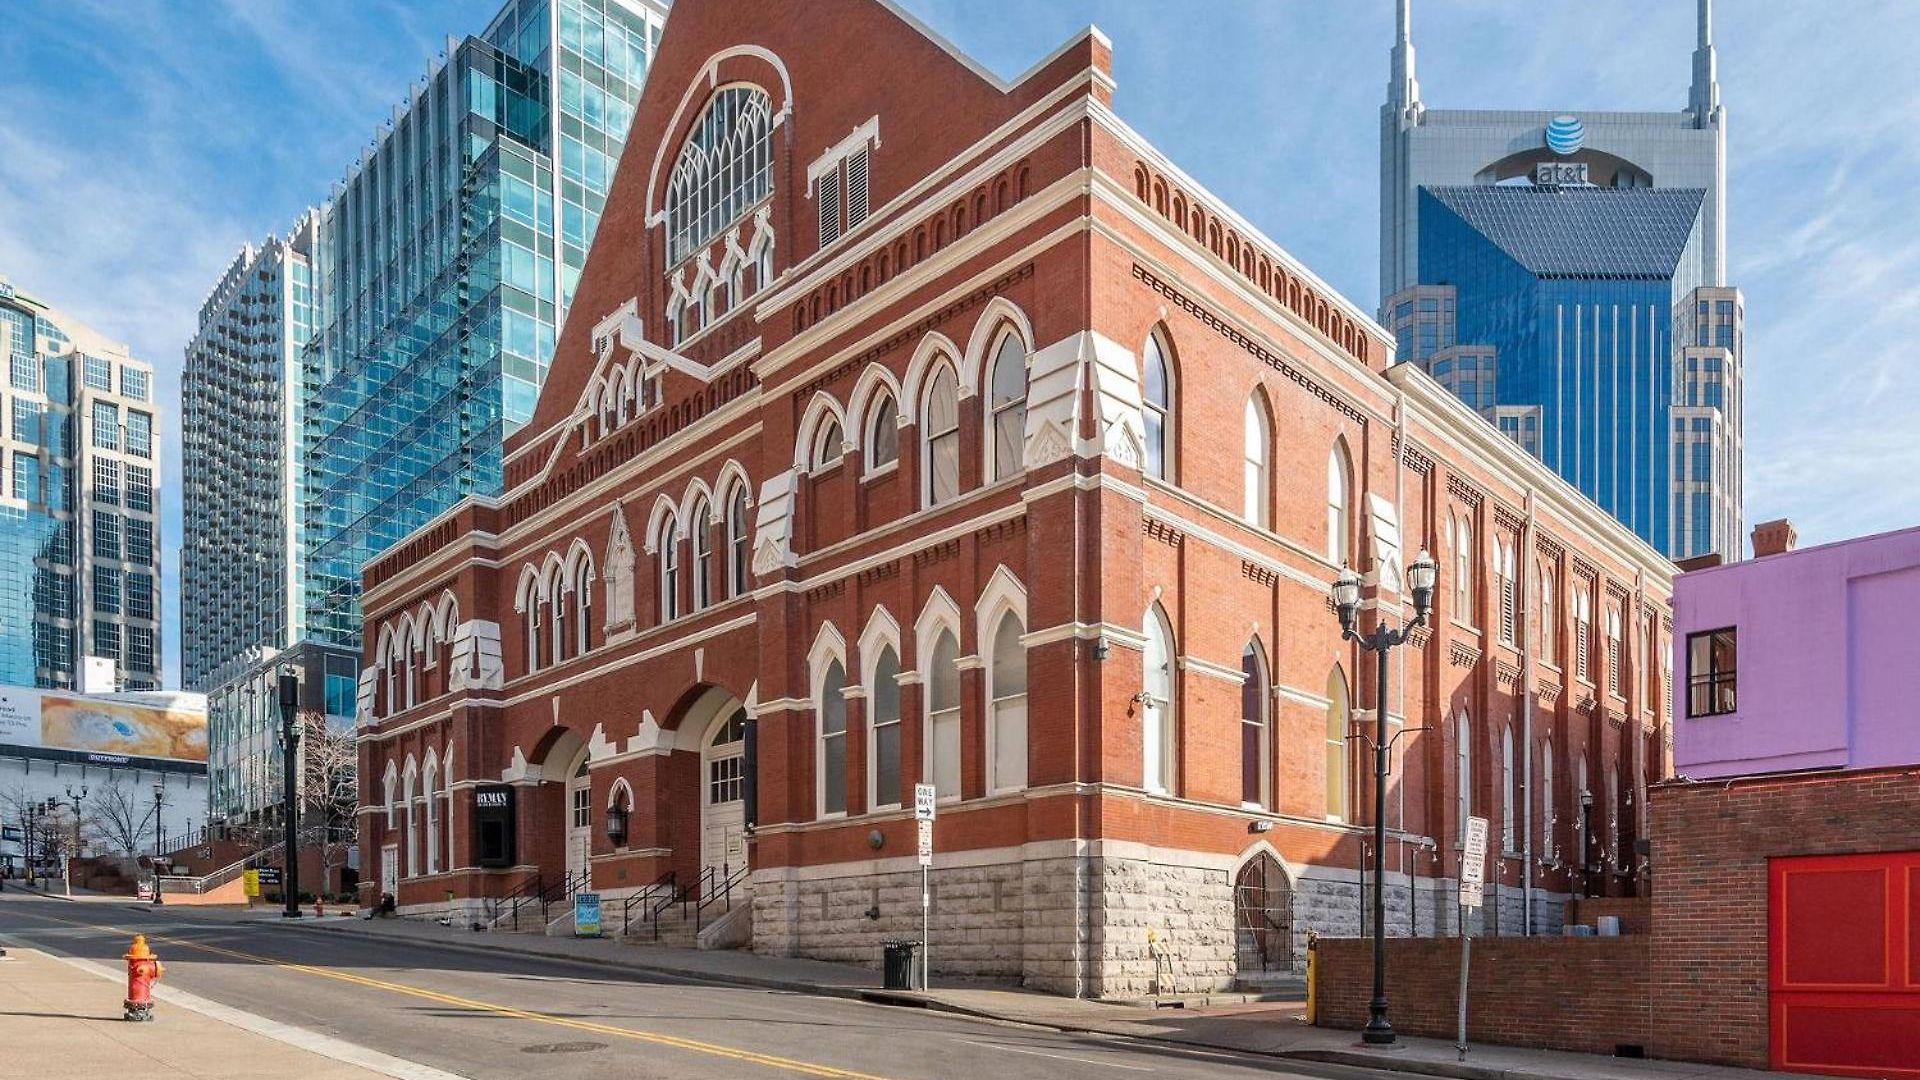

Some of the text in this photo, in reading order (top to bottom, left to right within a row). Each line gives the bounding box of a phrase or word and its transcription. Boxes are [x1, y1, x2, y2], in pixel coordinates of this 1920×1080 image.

[1540, 164, 1586, 184] at&t
[918, 787, 932, 796] ONE
[477, 793, 507, 803] RYMAN
[918, 797, 933, 805] WAY
